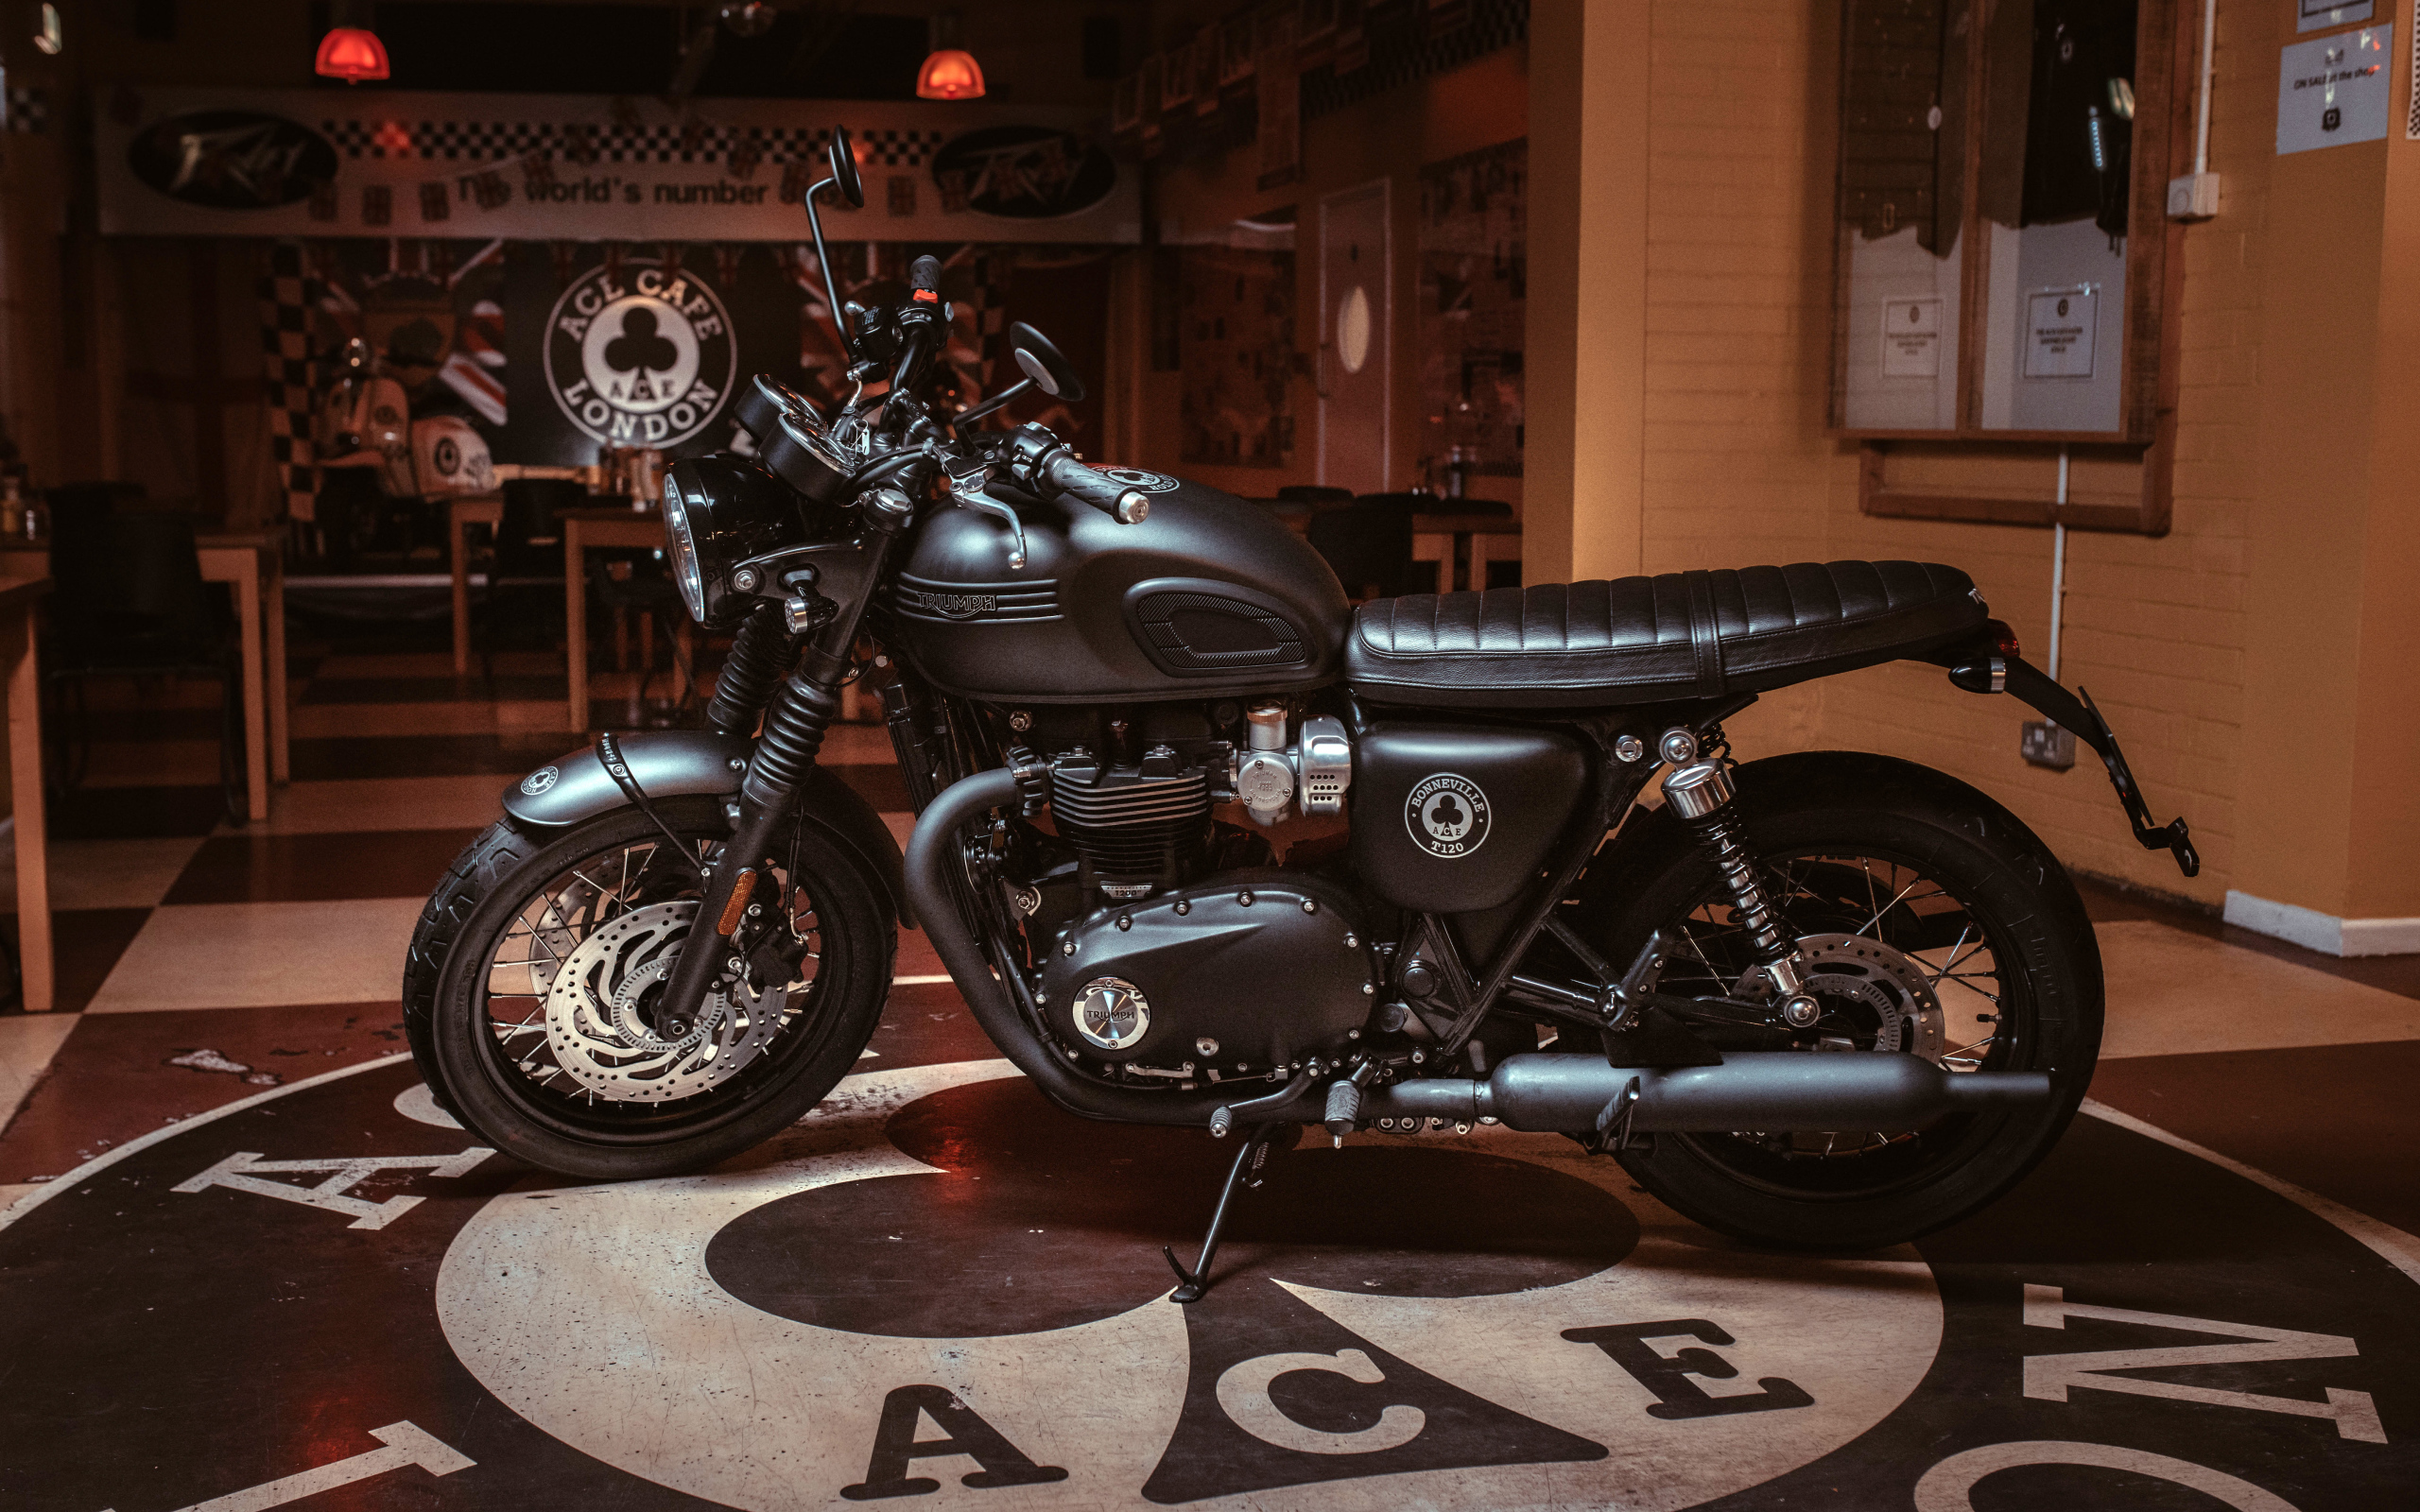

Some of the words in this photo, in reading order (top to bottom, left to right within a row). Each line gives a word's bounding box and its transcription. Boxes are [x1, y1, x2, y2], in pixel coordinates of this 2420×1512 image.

[654, 180, 769, 204] number
[636, 268, 724, 342] CAFE
[609, 379, 676, 400] ACE
[562, 378, 719, 441] LONDON
[917, 593, 996, 615] TRIUMPH
[1411, 779, 1485, 813] BONNEVILLE
[1432, 826, 1461, 836] ACE
[1430, 840, 1464, 853] T120
[1086, 1010, 1134, 1021] TRIUMPH
[839, 1317, 1816, 1501] ACE
